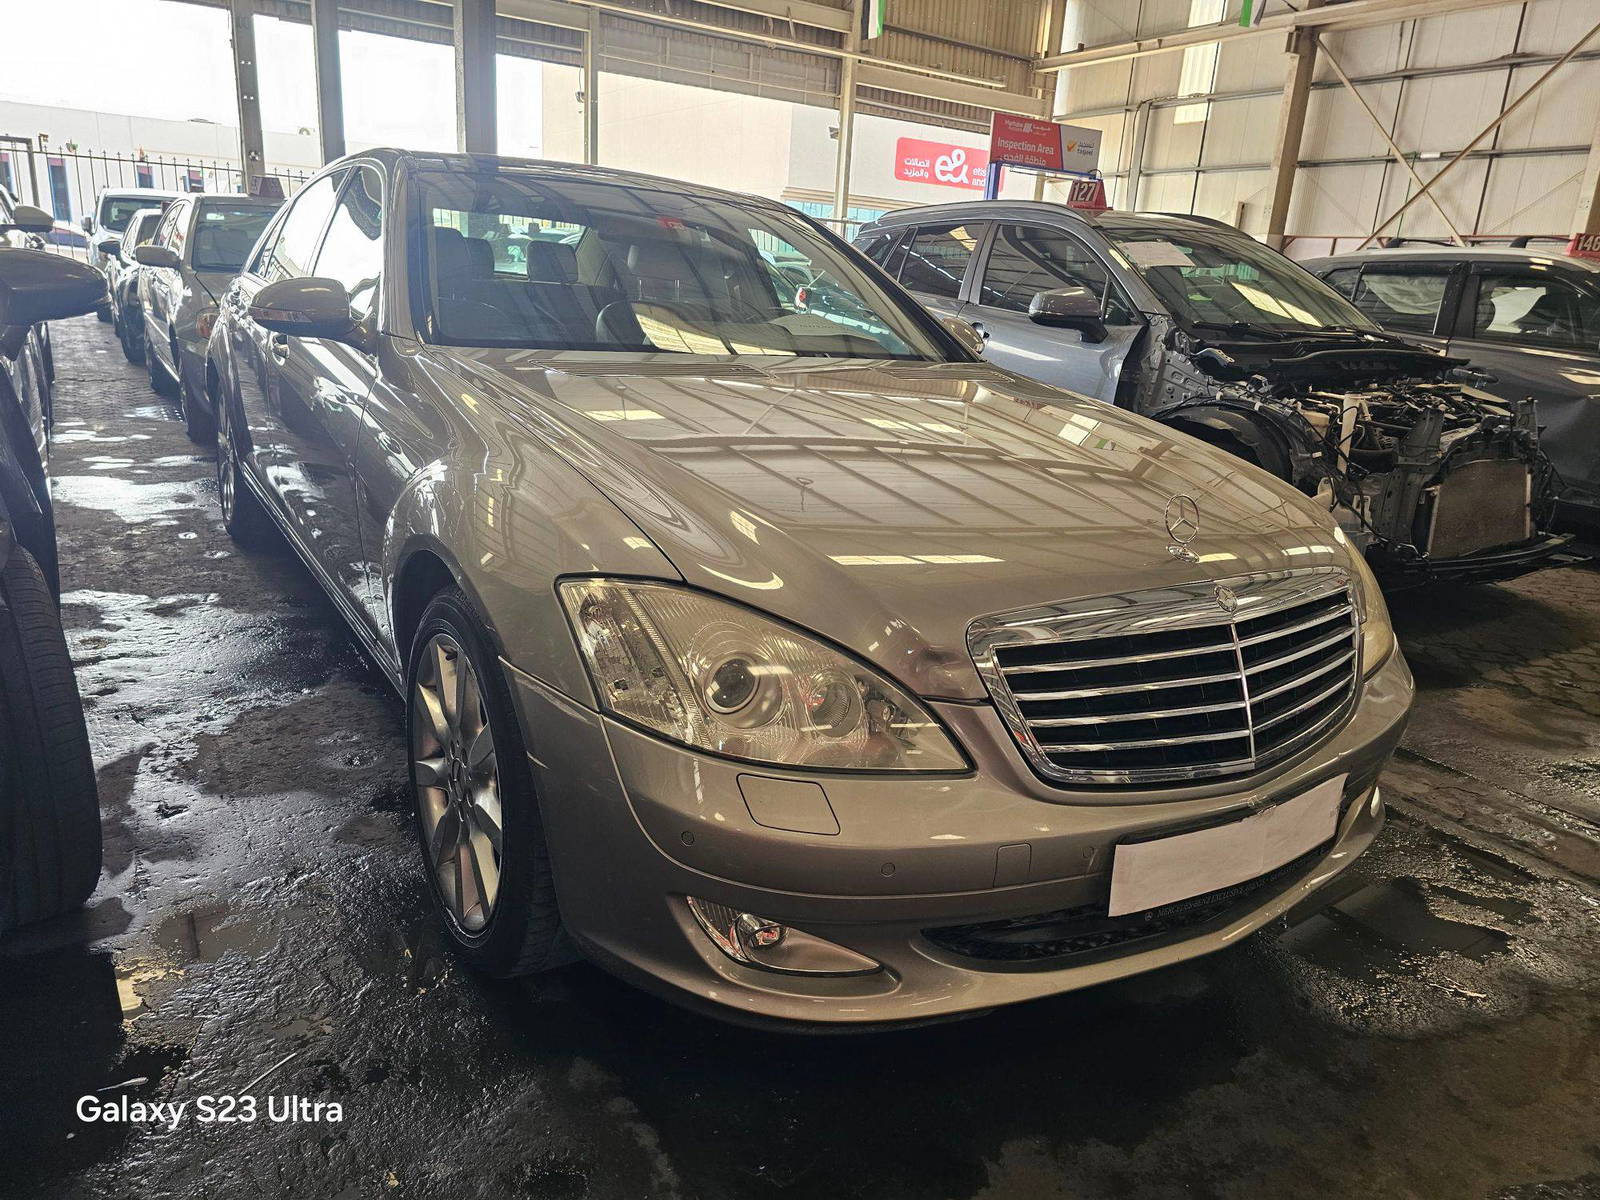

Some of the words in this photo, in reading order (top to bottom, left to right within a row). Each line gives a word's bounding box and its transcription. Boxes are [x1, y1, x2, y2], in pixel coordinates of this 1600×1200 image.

[998, 136, 1036, 151] Inspection
[1037, 144, 1055, 155] Area
[903, 157, 930, 168] اتصالات
[903, 168, 929, 179] والمزيد
[1072, 182, 1096, 202] 127
